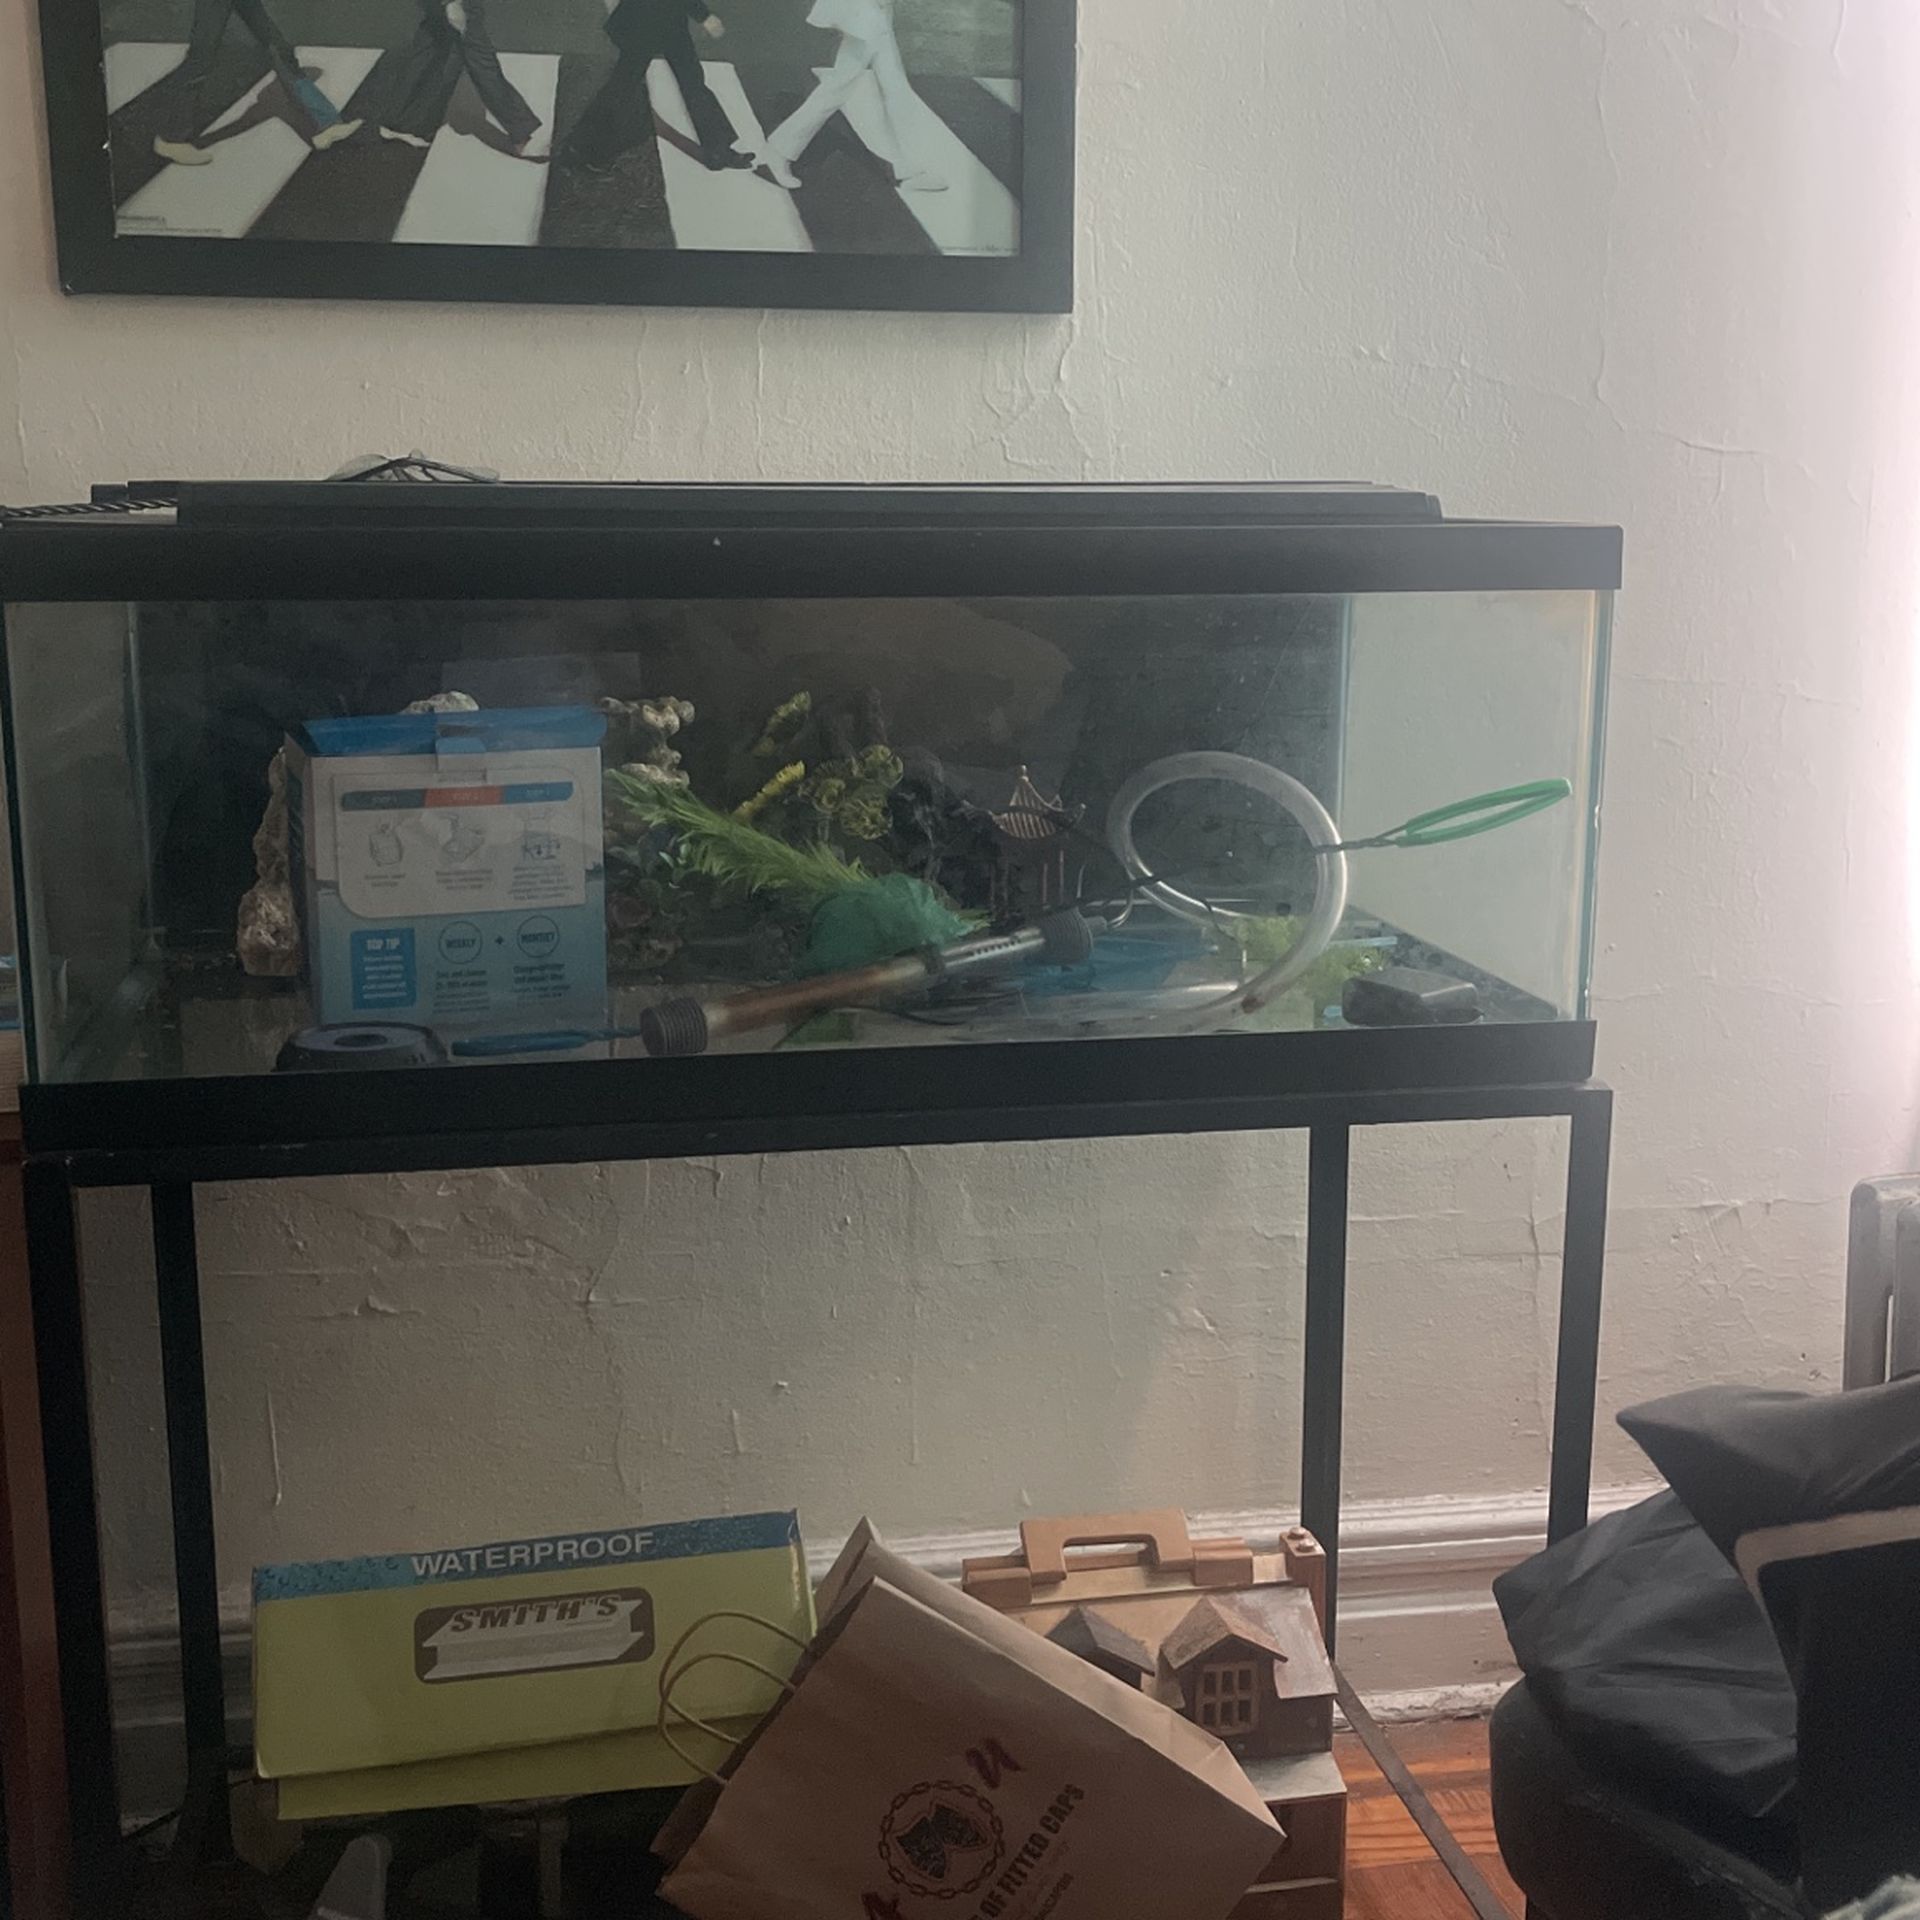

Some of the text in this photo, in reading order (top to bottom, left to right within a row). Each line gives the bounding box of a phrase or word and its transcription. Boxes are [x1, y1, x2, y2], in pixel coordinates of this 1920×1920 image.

[385, 936, 401, 950] TIP
[445, 938, 477, 949] WEEKLY
[411, 1531, 654, 1576] WATERPROOF
[450, 1594, 622, 1633] SMITH'S
[979, 1890, 1008, 1919] OF
[997, 1832, 1050, 1896] FITTED
[1040, 1784, 1085, 1834] CAPS
